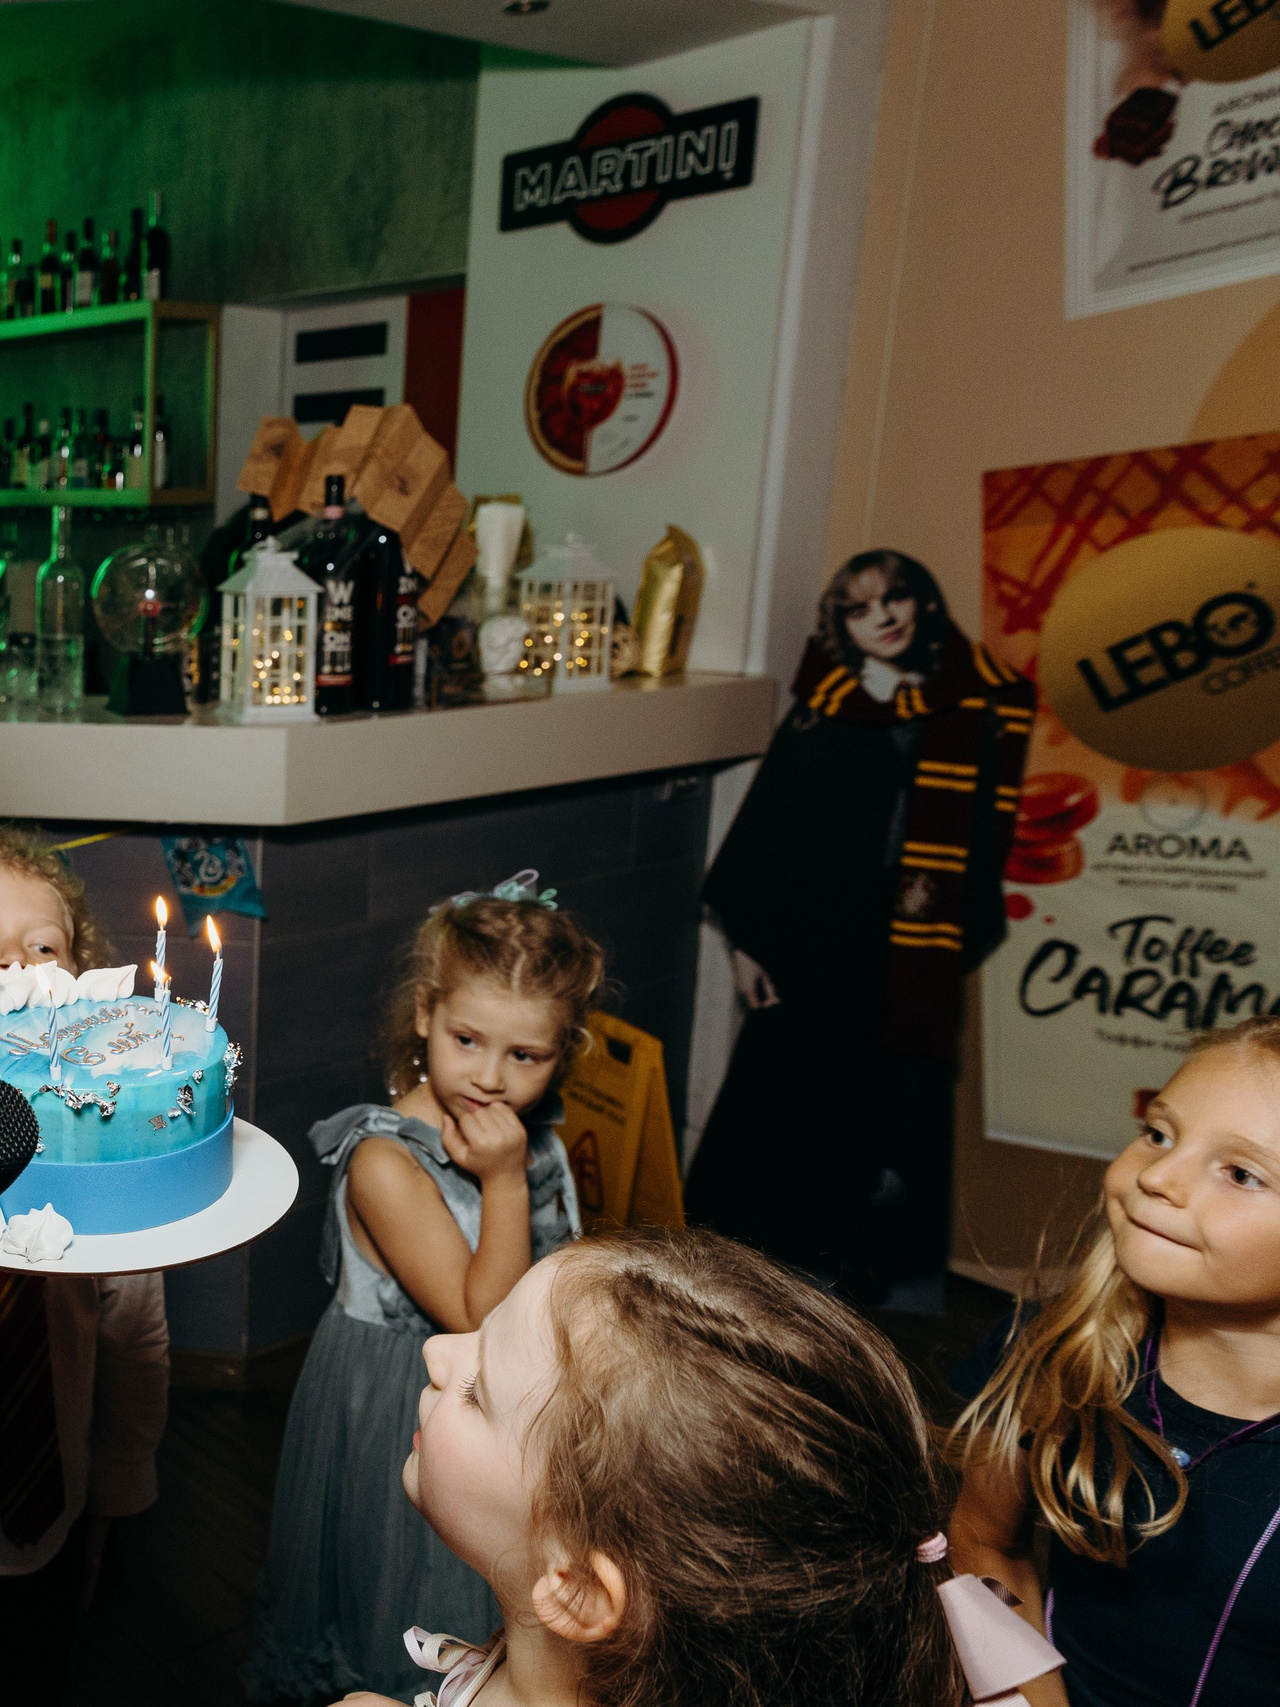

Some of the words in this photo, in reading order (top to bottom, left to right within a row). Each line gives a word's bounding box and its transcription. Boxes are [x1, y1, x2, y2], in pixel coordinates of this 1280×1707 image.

[513, 120, 740, 212] MARTINI
[1076, 592, 1275, 712] LEBO
[1105, 831, 1252, 863] AROMA
[1108, 914, 1257, 978] Toffee
